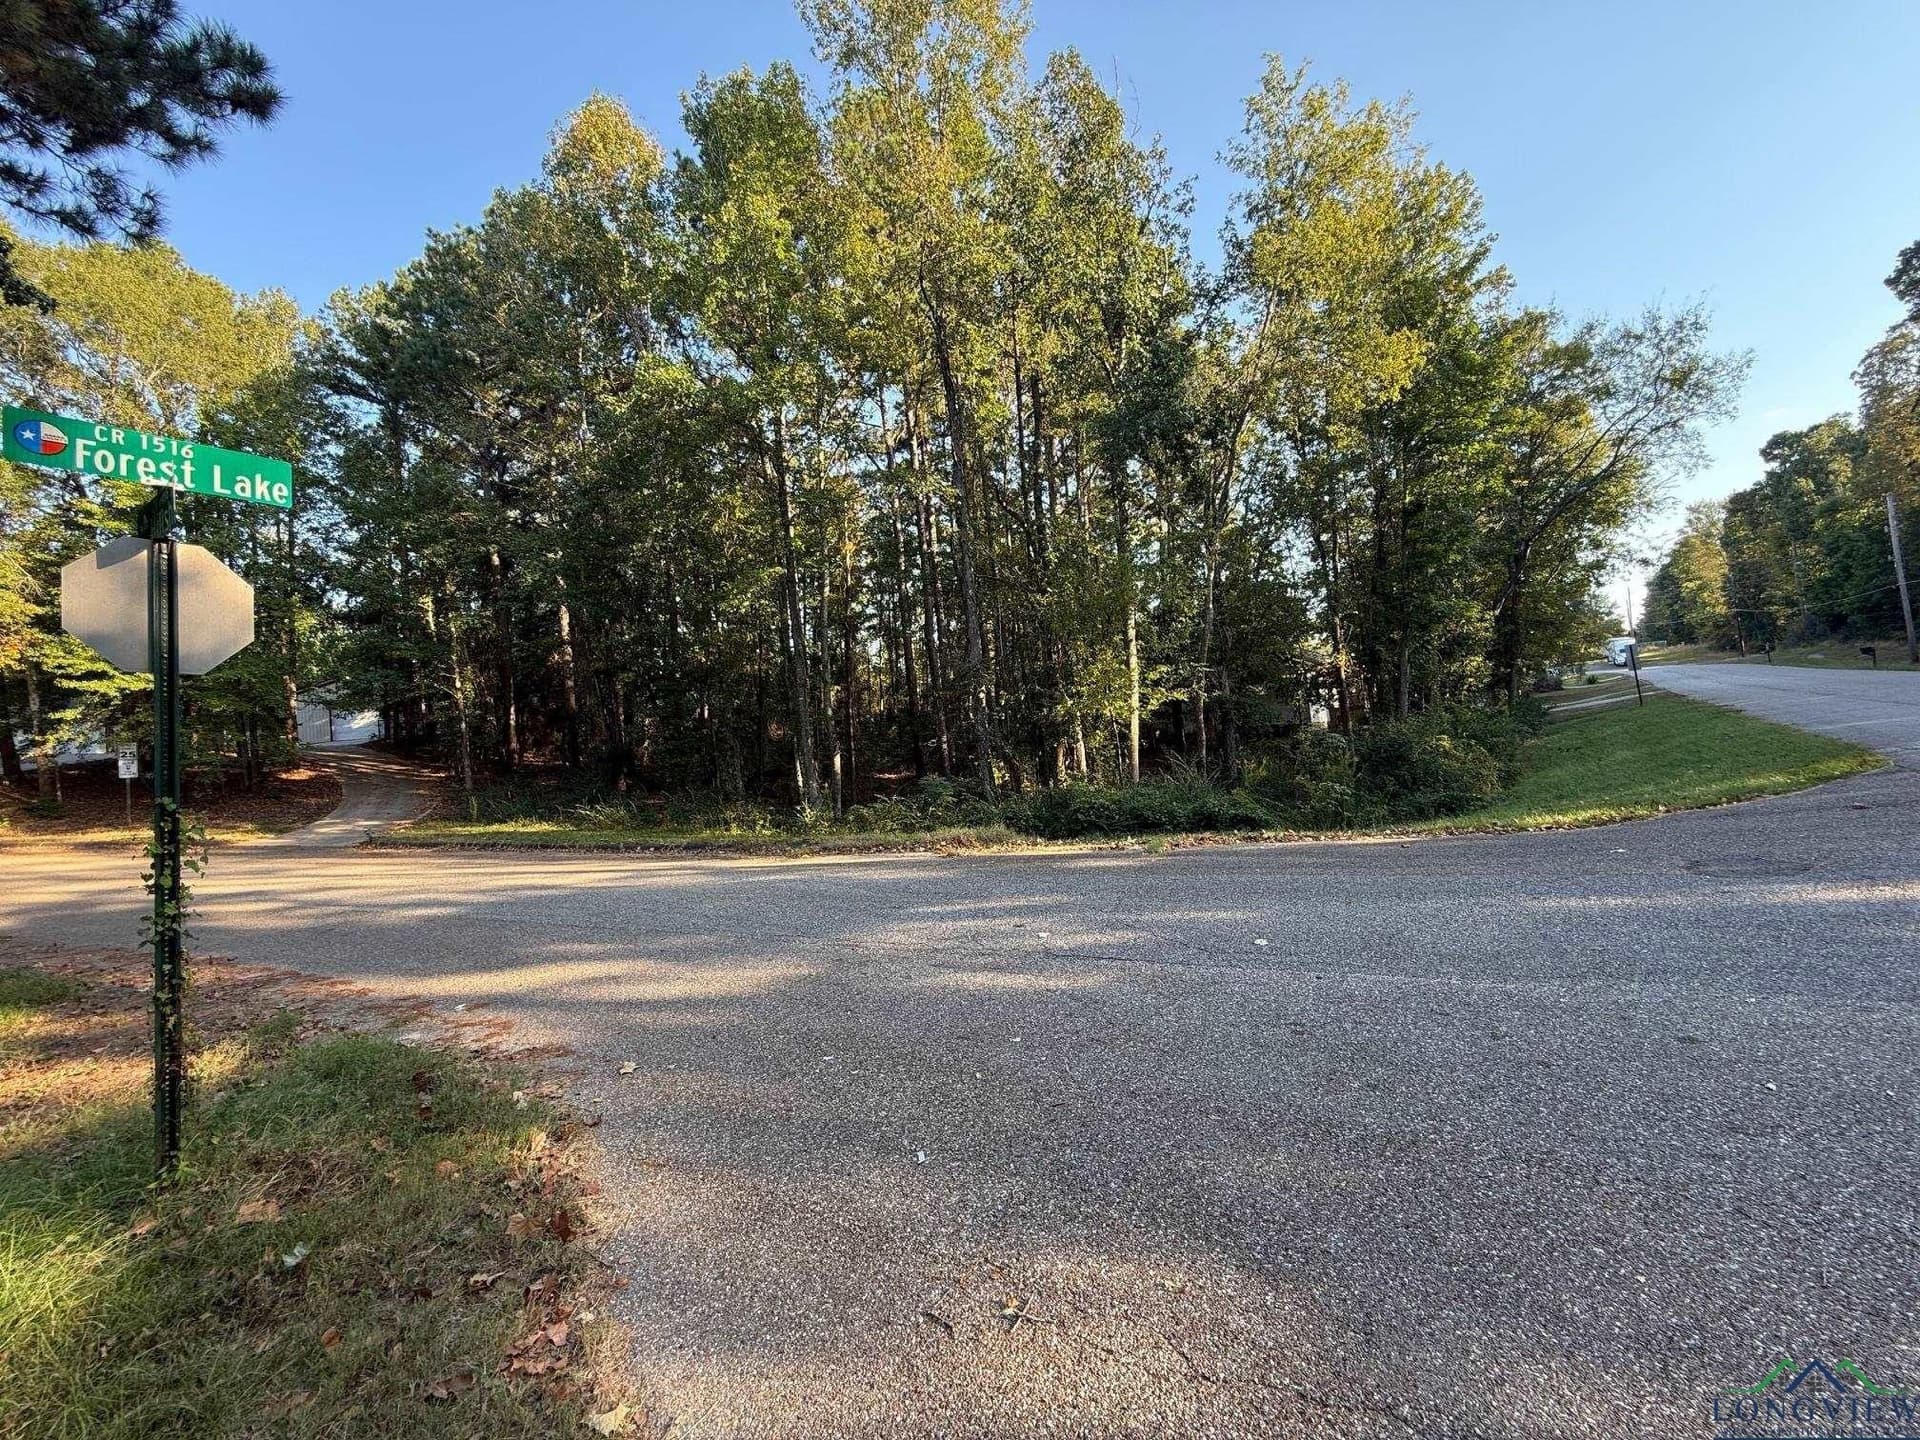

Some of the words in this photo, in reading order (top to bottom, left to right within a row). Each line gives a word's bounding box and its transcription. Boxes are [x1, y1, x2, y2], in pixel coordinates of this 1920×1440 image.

[94, 426, 125, 445] CR
[140, 435, 194, 459] 1516
[74, 438, 196, 489] Forest
[213, 464, 289, 505] Lake
